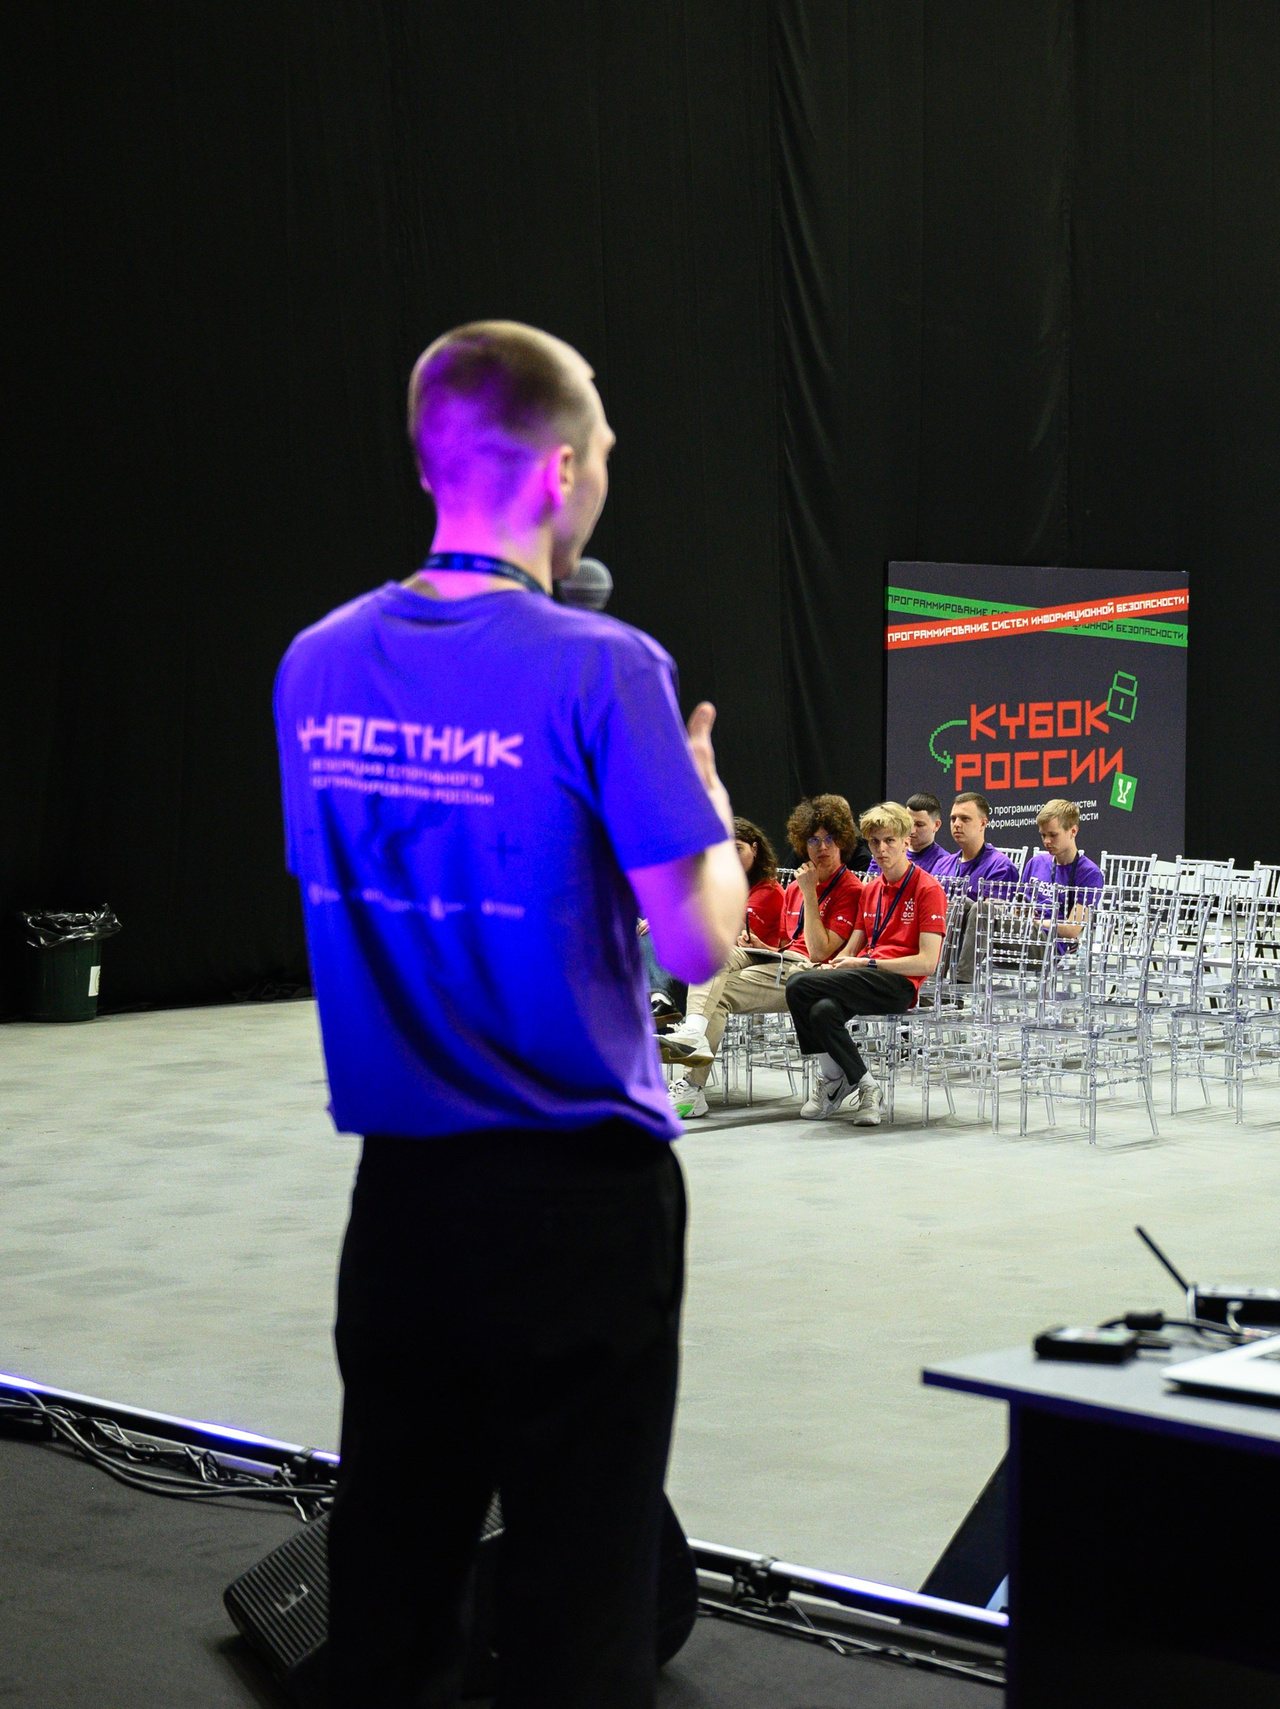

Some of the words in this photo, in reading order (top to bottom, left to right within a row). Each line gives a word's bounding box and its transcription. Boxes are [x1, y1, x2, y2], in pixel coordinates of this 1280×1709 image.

[887, 622, 989, 643] ПРОГРАММИРОВАНИЕ
[991, 617, 1029, 631] СИСТЕМ
[1031, 602, 1115, 626] ИНФОРМАЦИОННОЙ
[1116, 596, 1185, 613] БЕЗОПАСНОСТИ
[1115, 623, 1185, 640] БЕЗОПАСНОСТИ
[969, 700, 1110, 741] КУБОК
[955, 747, 1123, 791] РОССИИ
